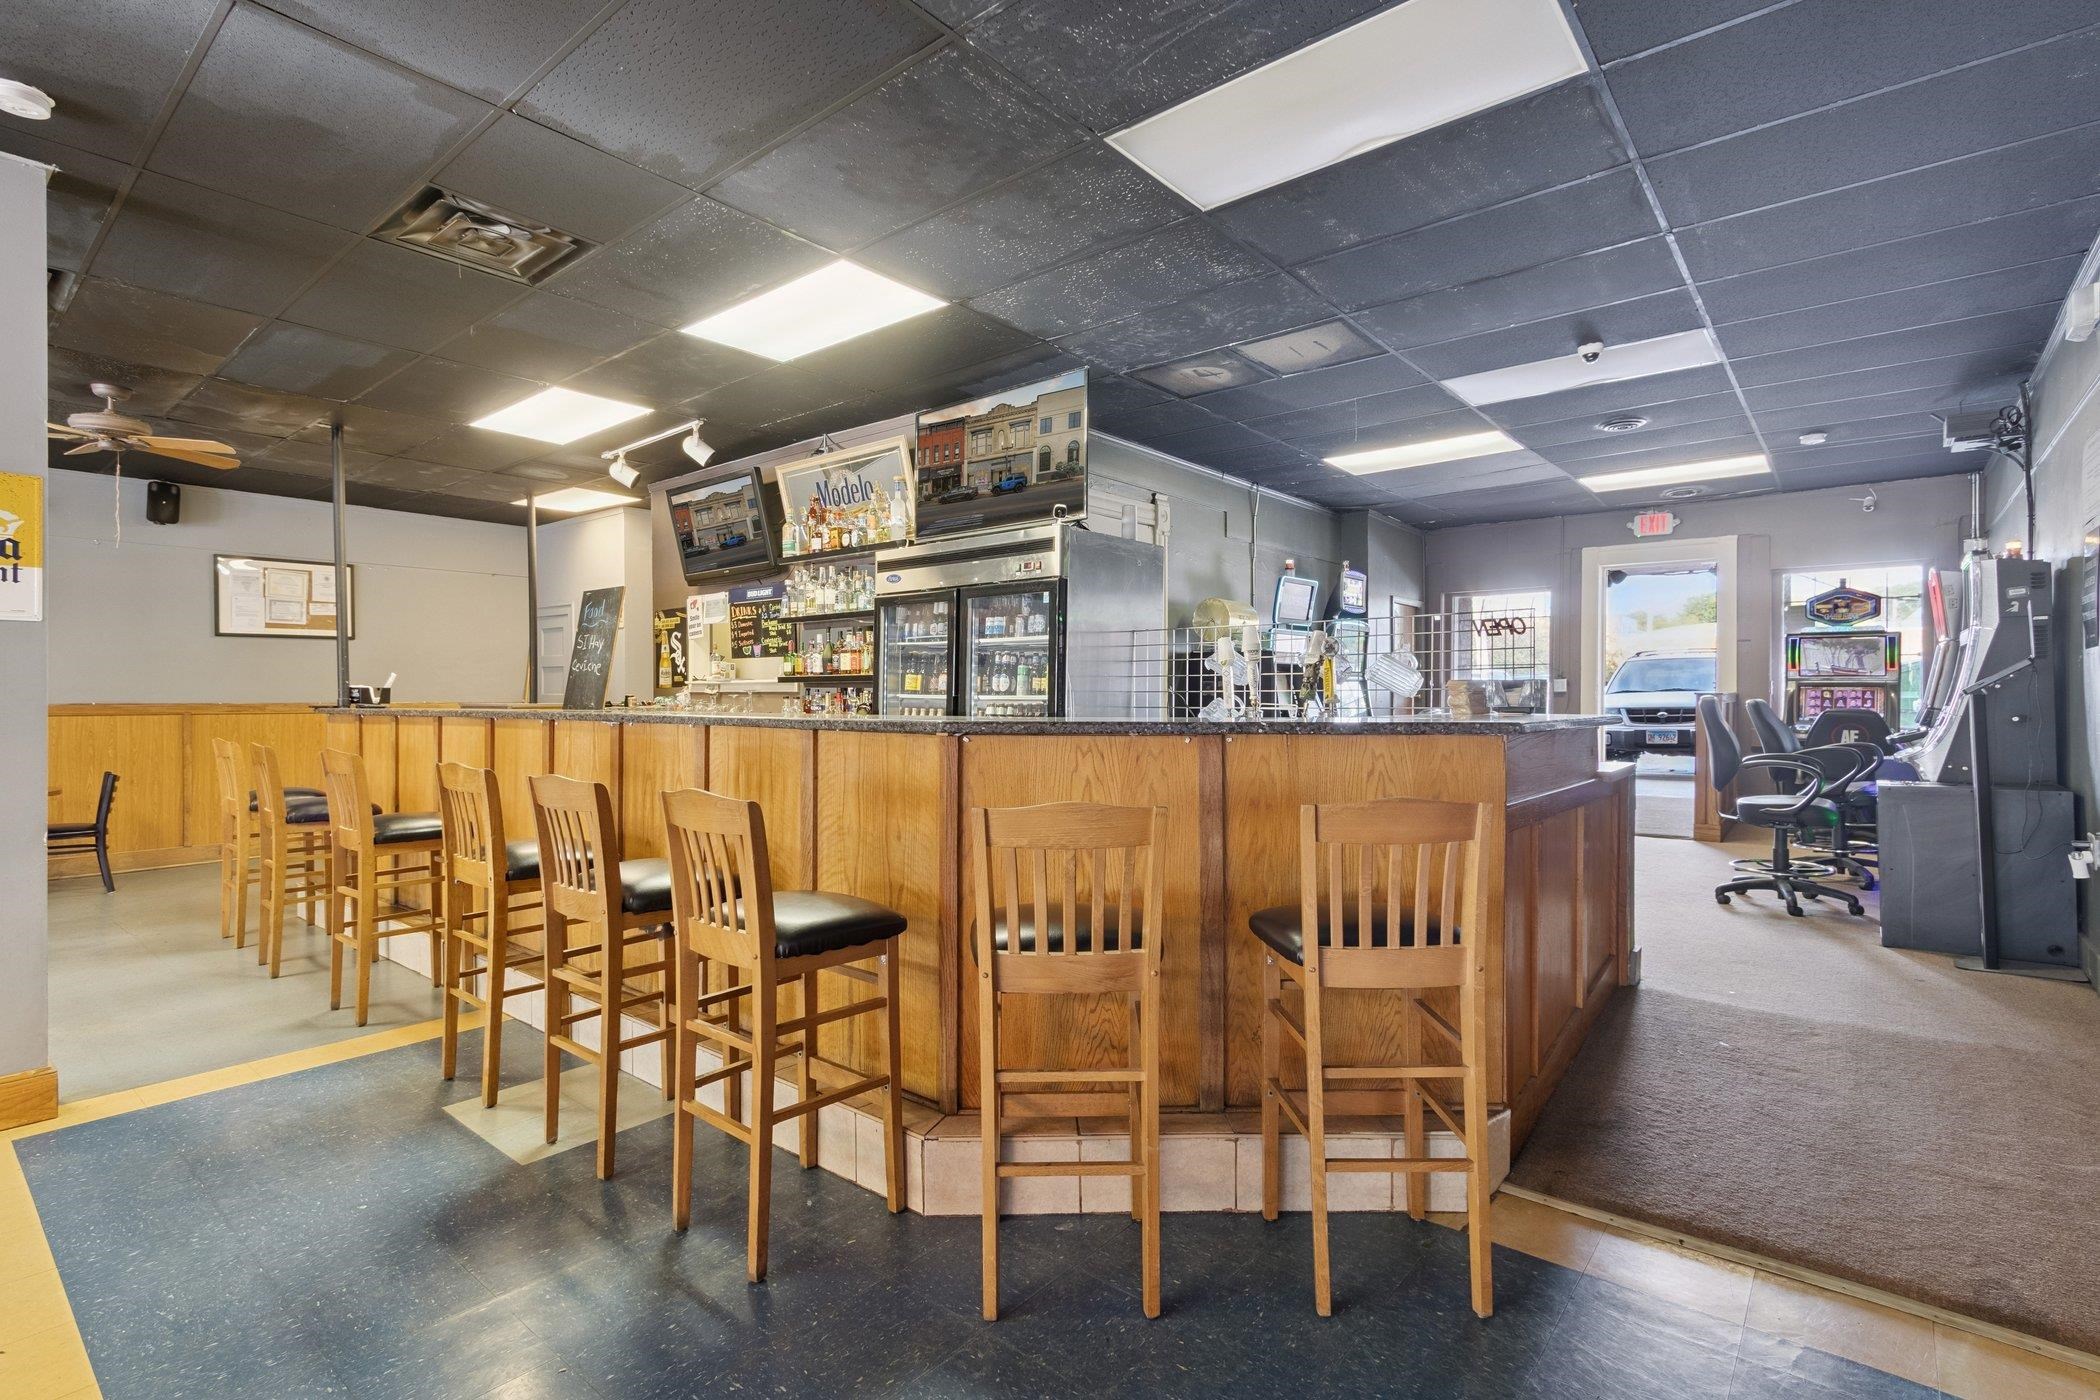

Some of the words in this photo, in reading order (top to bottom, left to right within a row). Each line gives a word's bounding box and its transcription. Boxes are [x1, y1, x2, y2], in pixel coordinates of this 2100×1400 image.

[815, 474, 874, 508] Modelo
[1639, 513, 1668, 533] EXIT
[584, 599, 606, 621] Food
[731, 605, 757, 617] DRINKS
